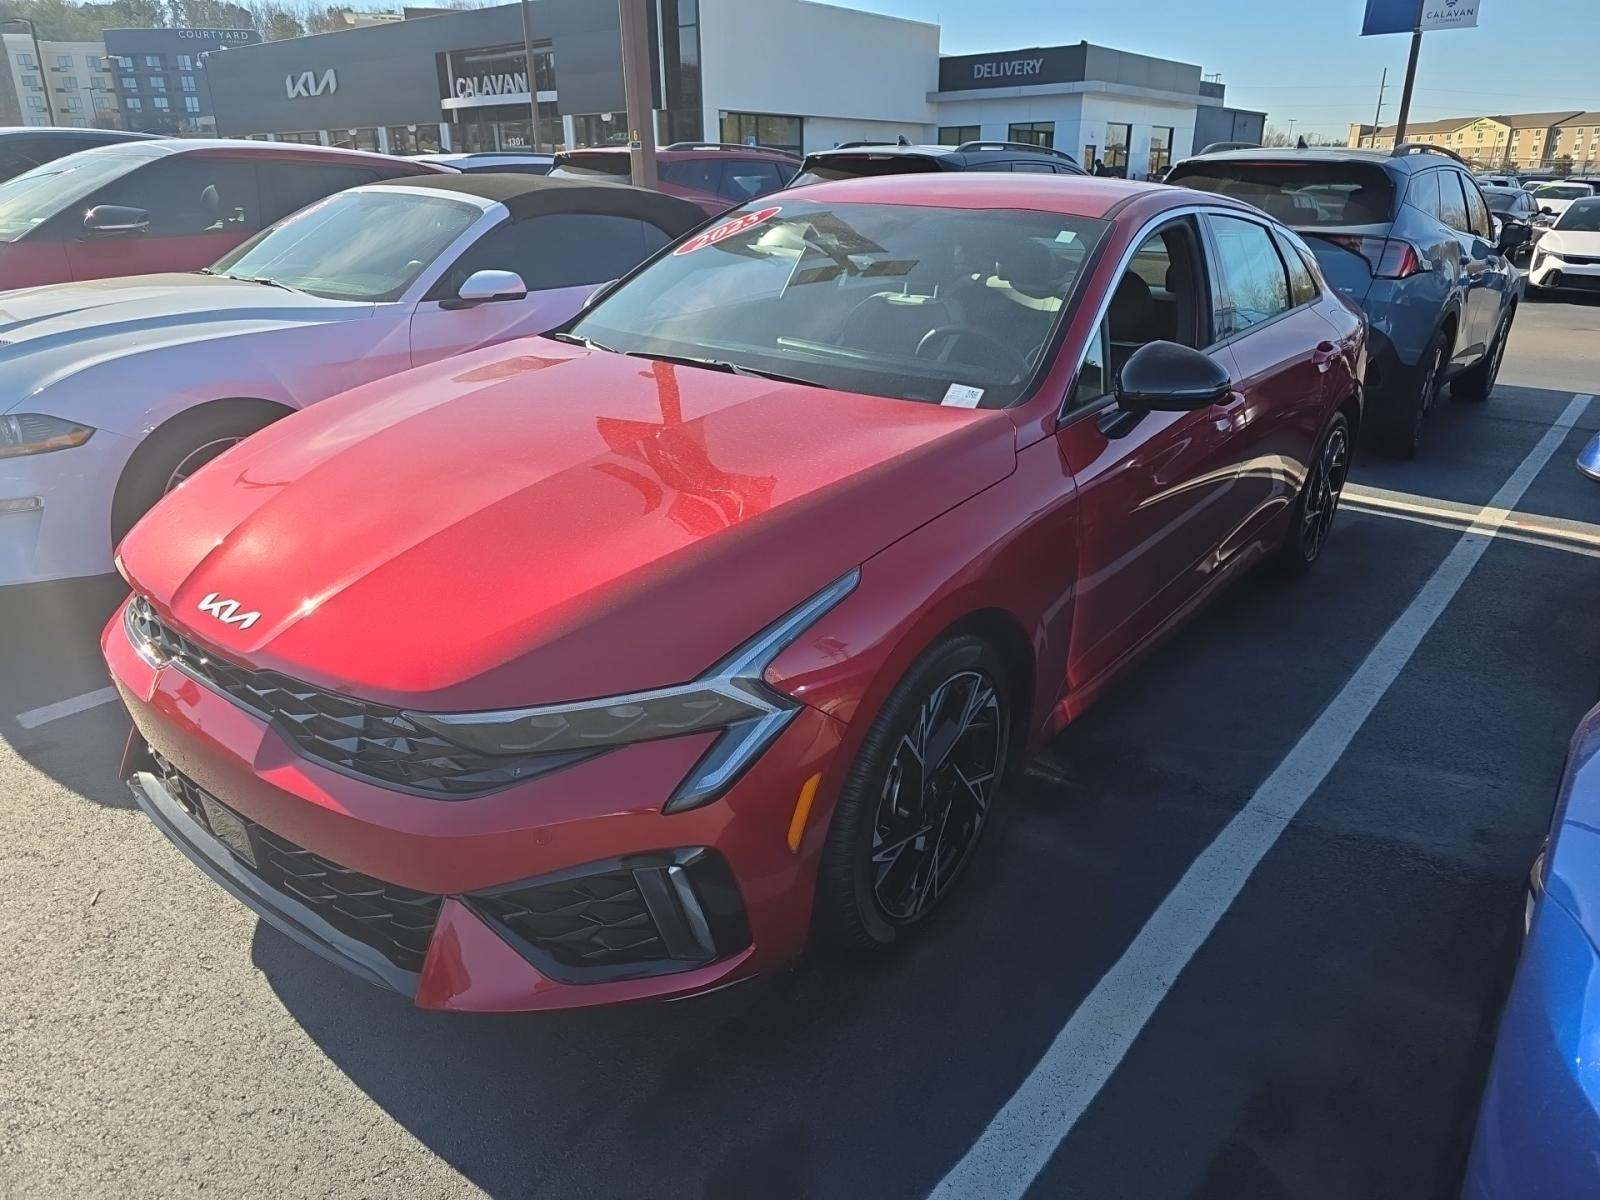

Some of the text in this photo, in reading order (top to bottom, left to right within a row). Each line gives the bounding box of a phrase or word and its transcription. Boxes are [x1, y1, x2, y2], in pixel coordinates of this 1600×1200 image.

[1426, 9, 1474, 19] CALAVAN
[178, 30, 249, 40] COURTYARD
[974, 58, 1043, 79] DELIVERY
[286, 69, 337, 98] KIA
[456, 72, 528, 99] CALAVAN
[197, 592, 261, 630] KIA
